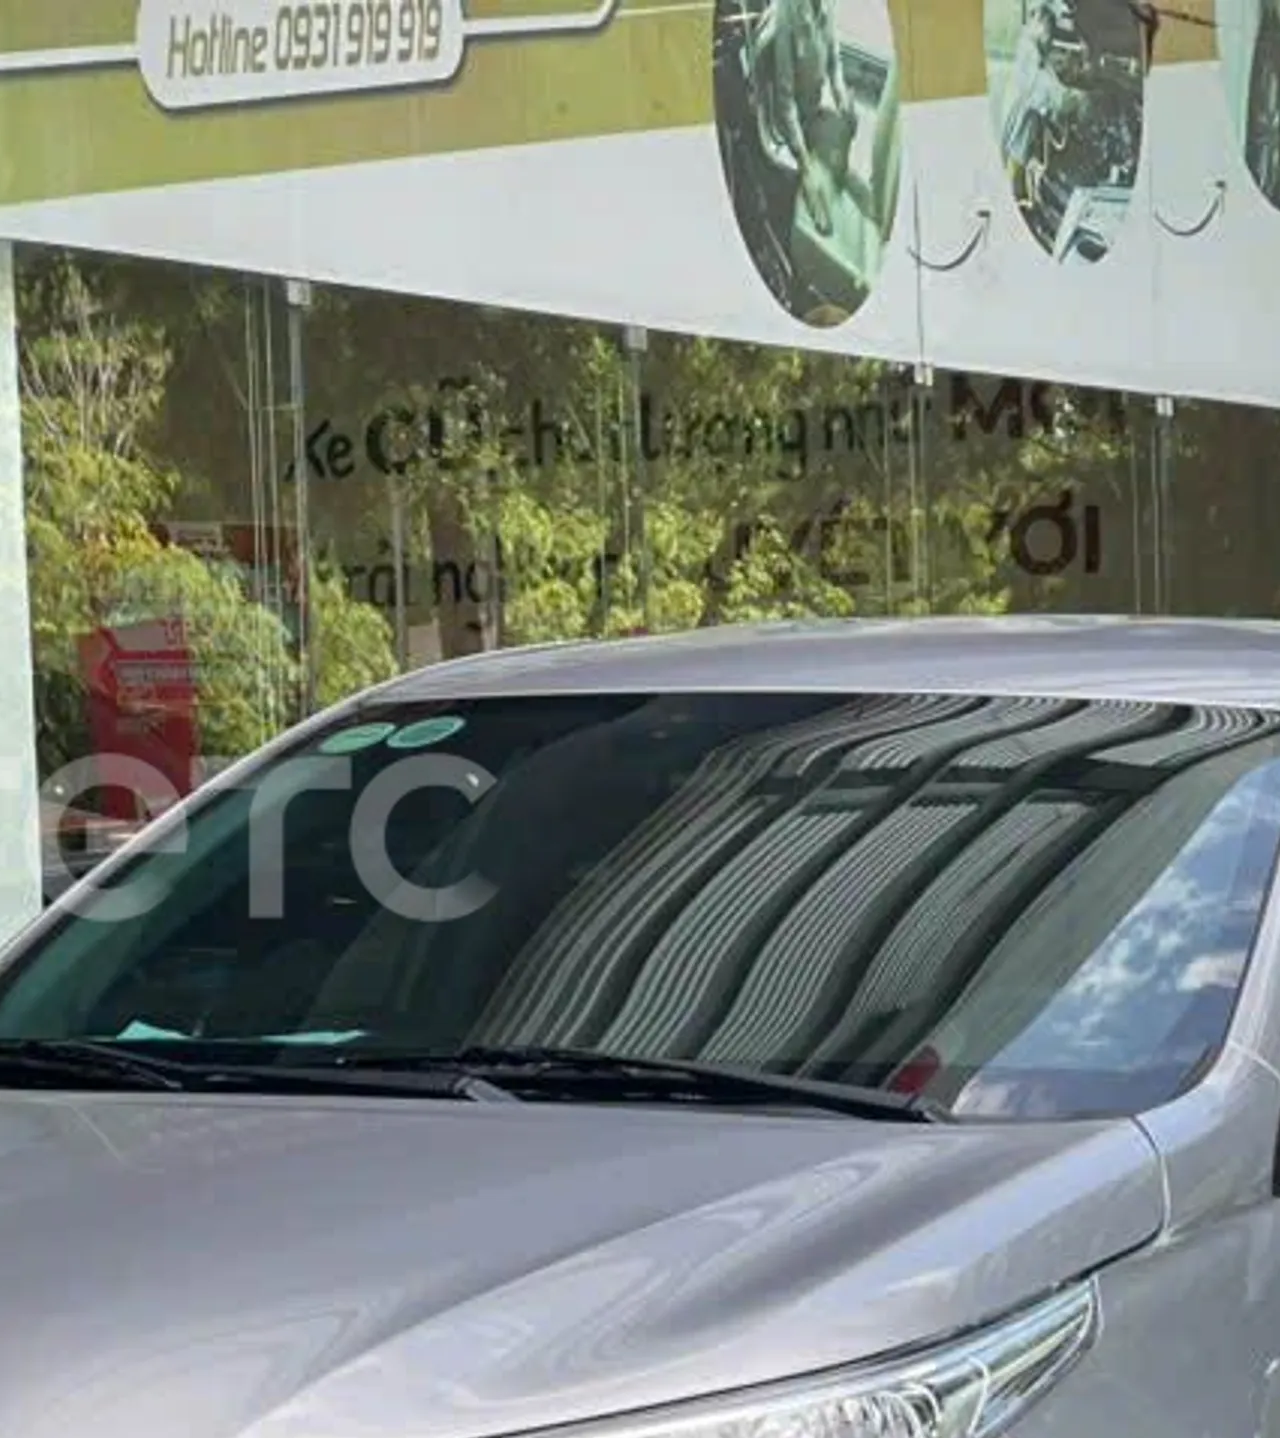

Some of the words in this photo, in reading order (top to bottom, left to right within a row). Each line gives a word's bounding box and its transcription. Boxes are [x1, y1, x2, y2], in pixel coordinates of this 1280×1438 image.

[166, 12, 268, 79] Hotline
[275, 3, 341, 71] 0931
[346, 0, 392, 67] 919
